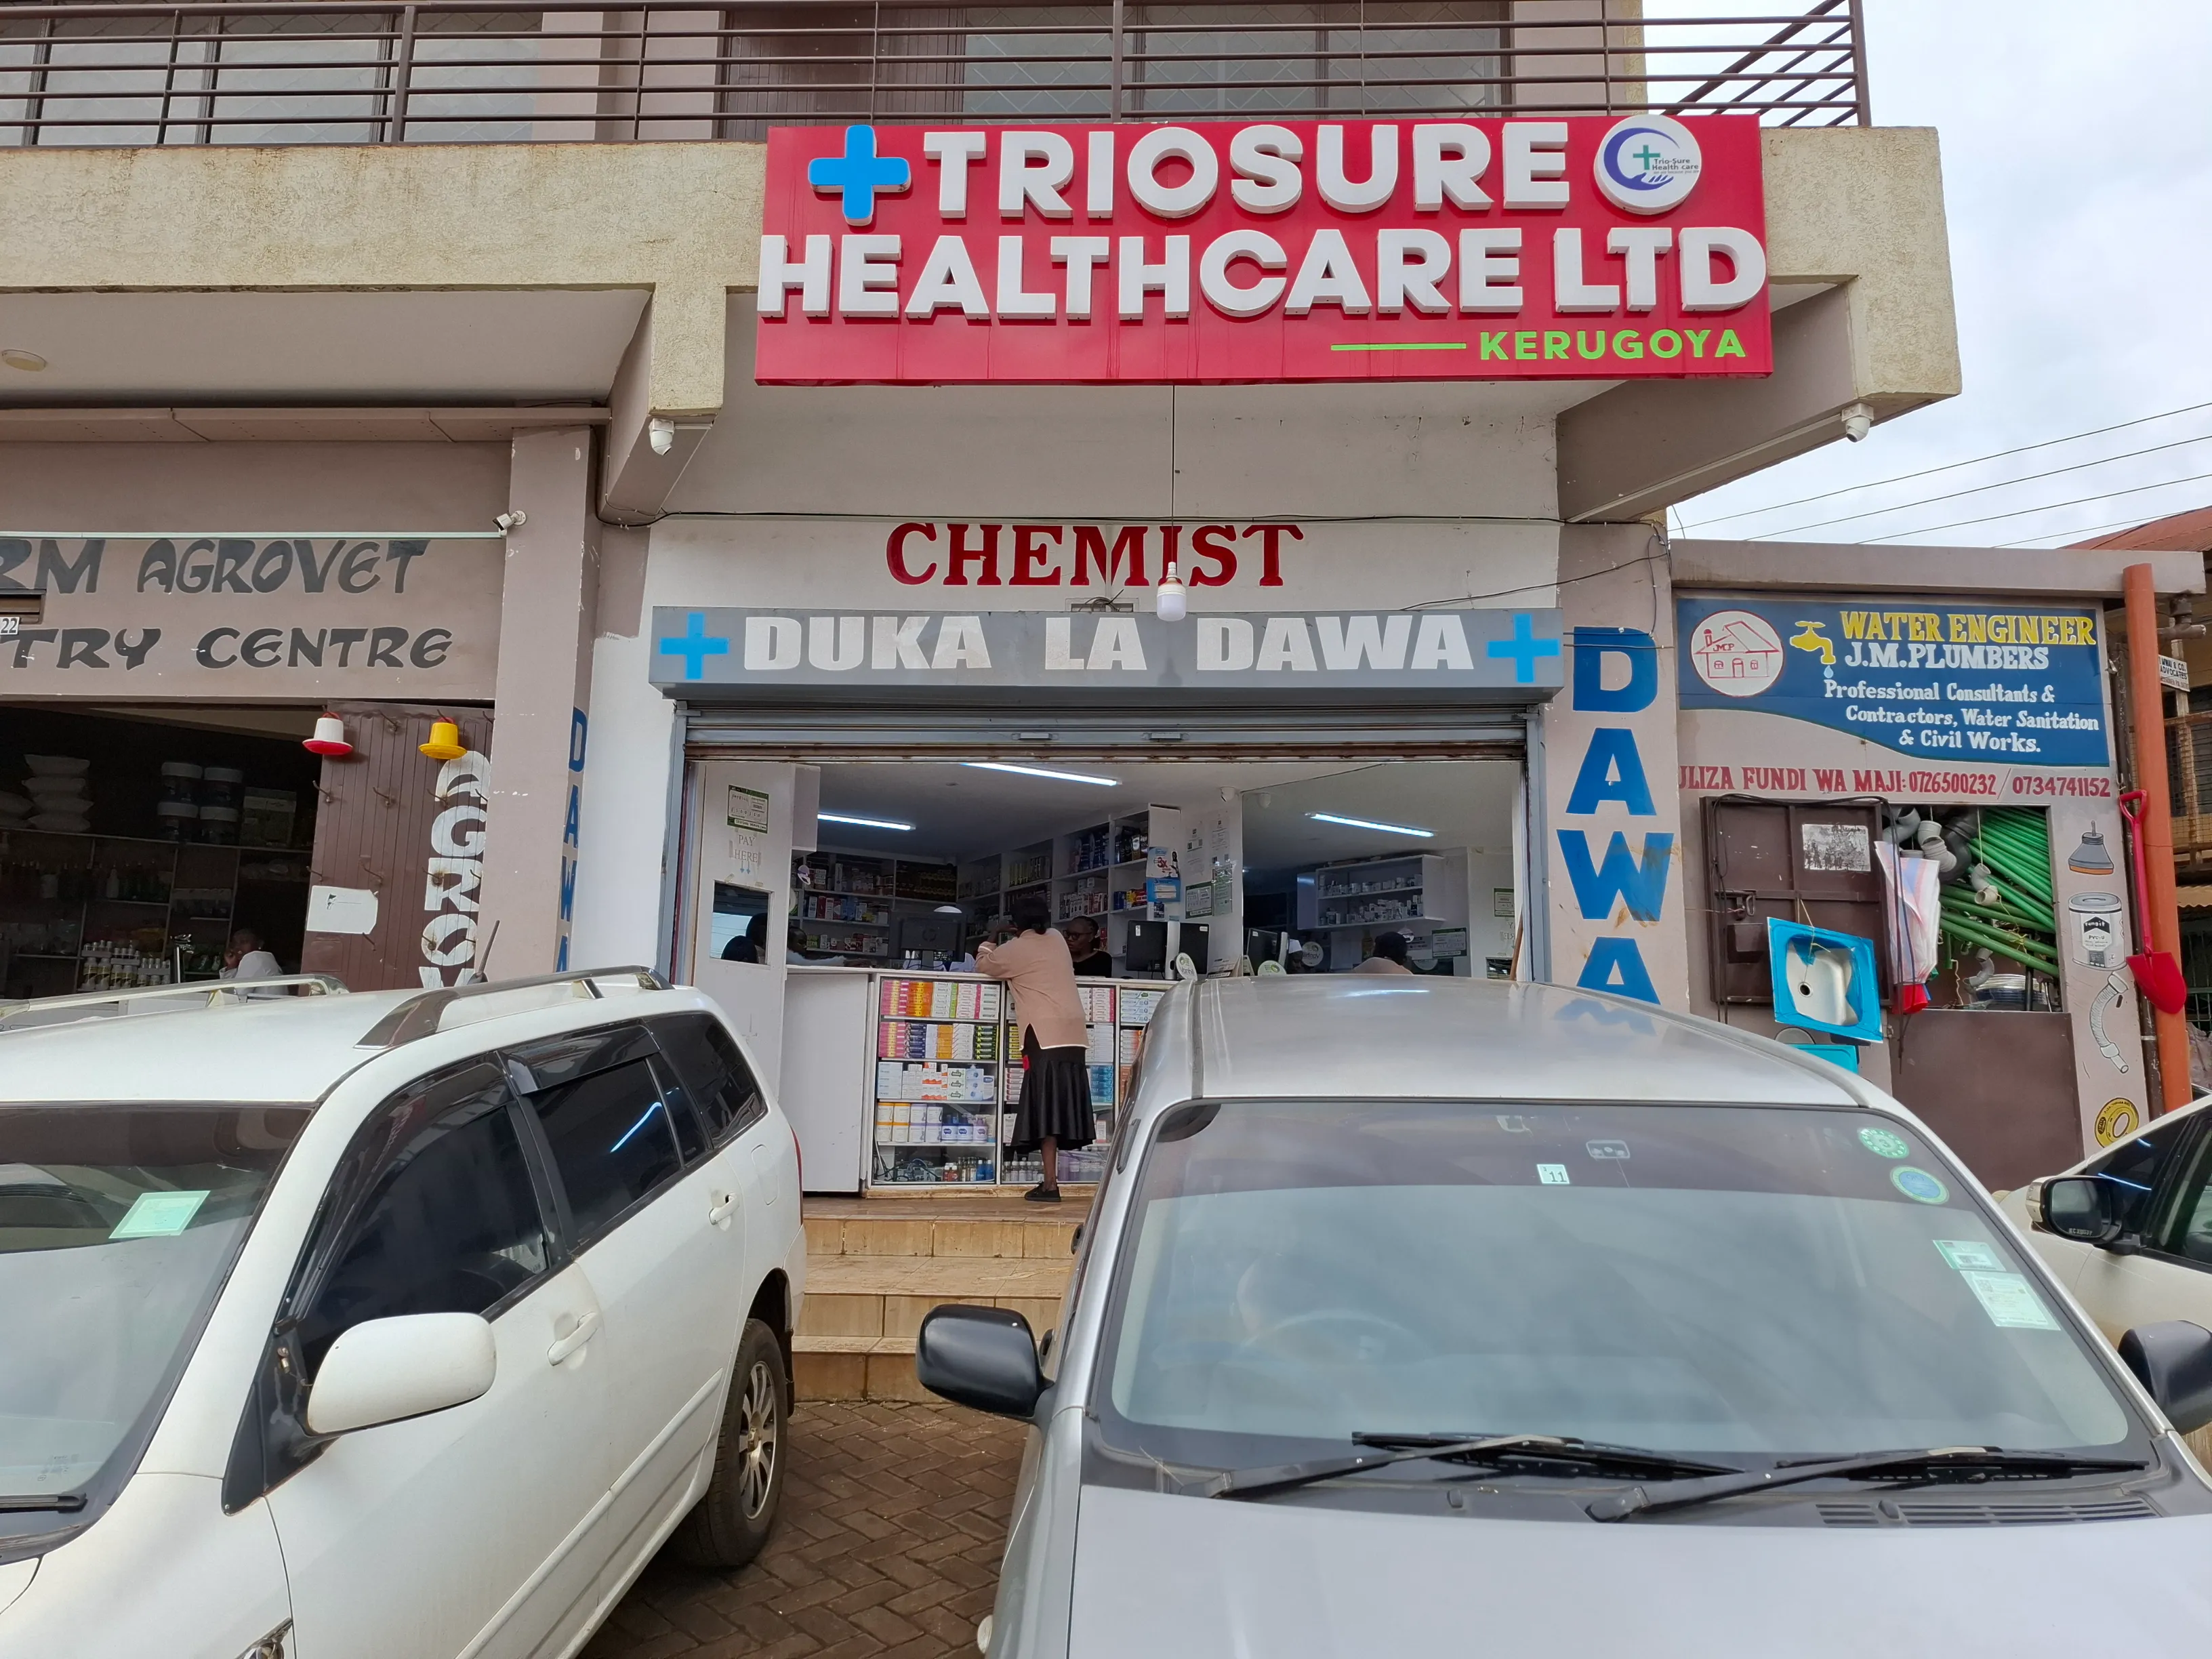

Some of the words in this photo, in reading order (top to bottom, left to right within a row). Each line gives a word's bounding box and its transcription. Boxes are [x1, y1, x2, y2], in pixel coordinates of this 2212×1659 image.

[924, 122, 1569, 218] TRIOSURE
[757, 228, 1523, 321] HEALTHCARE
[1553, 227, 1766, 312] LTD
[1480, 329, 1746, 360] KERUGOYA
[137, 539, 430, 594] AGROVET
[886, 522, 1303, 586] CHEMIST
[745, 616, 991, 670] DUKA
[1045, 616, 1147, 670] LA
[1197, 615, 1474, 671] DAWA
[1840, 611, 1945, 642] WATER
[1946, 613, 2096, 645] ENGINEER
[196, 626, 453, 670] CENTRE
[1824, 680, 1940, 700] Professional
[1946, 682, 2037, 703] Consultants
[2042, 684, 2055, 703] &
[1845, 705, 1958, 728] Contractors,
[1961, 708, 2011, 727] Water
[2015, 710, 2100, 731] Sanitation
[1899, 729, 1914, 745] &
[1920, 729, 1963, 748] Civil
[1967, 731, 2041, 752] Works.
[1741, 766, 1807, 792] FUNDI
[1811, 769, 1847, 792] WA
[1556, 626, 1675, 1006] DAWA
[735, 849, 758, 863] HERE
[738, 834, 755, 846] PAY
[1549, 1171, 1567, 1183] 11
